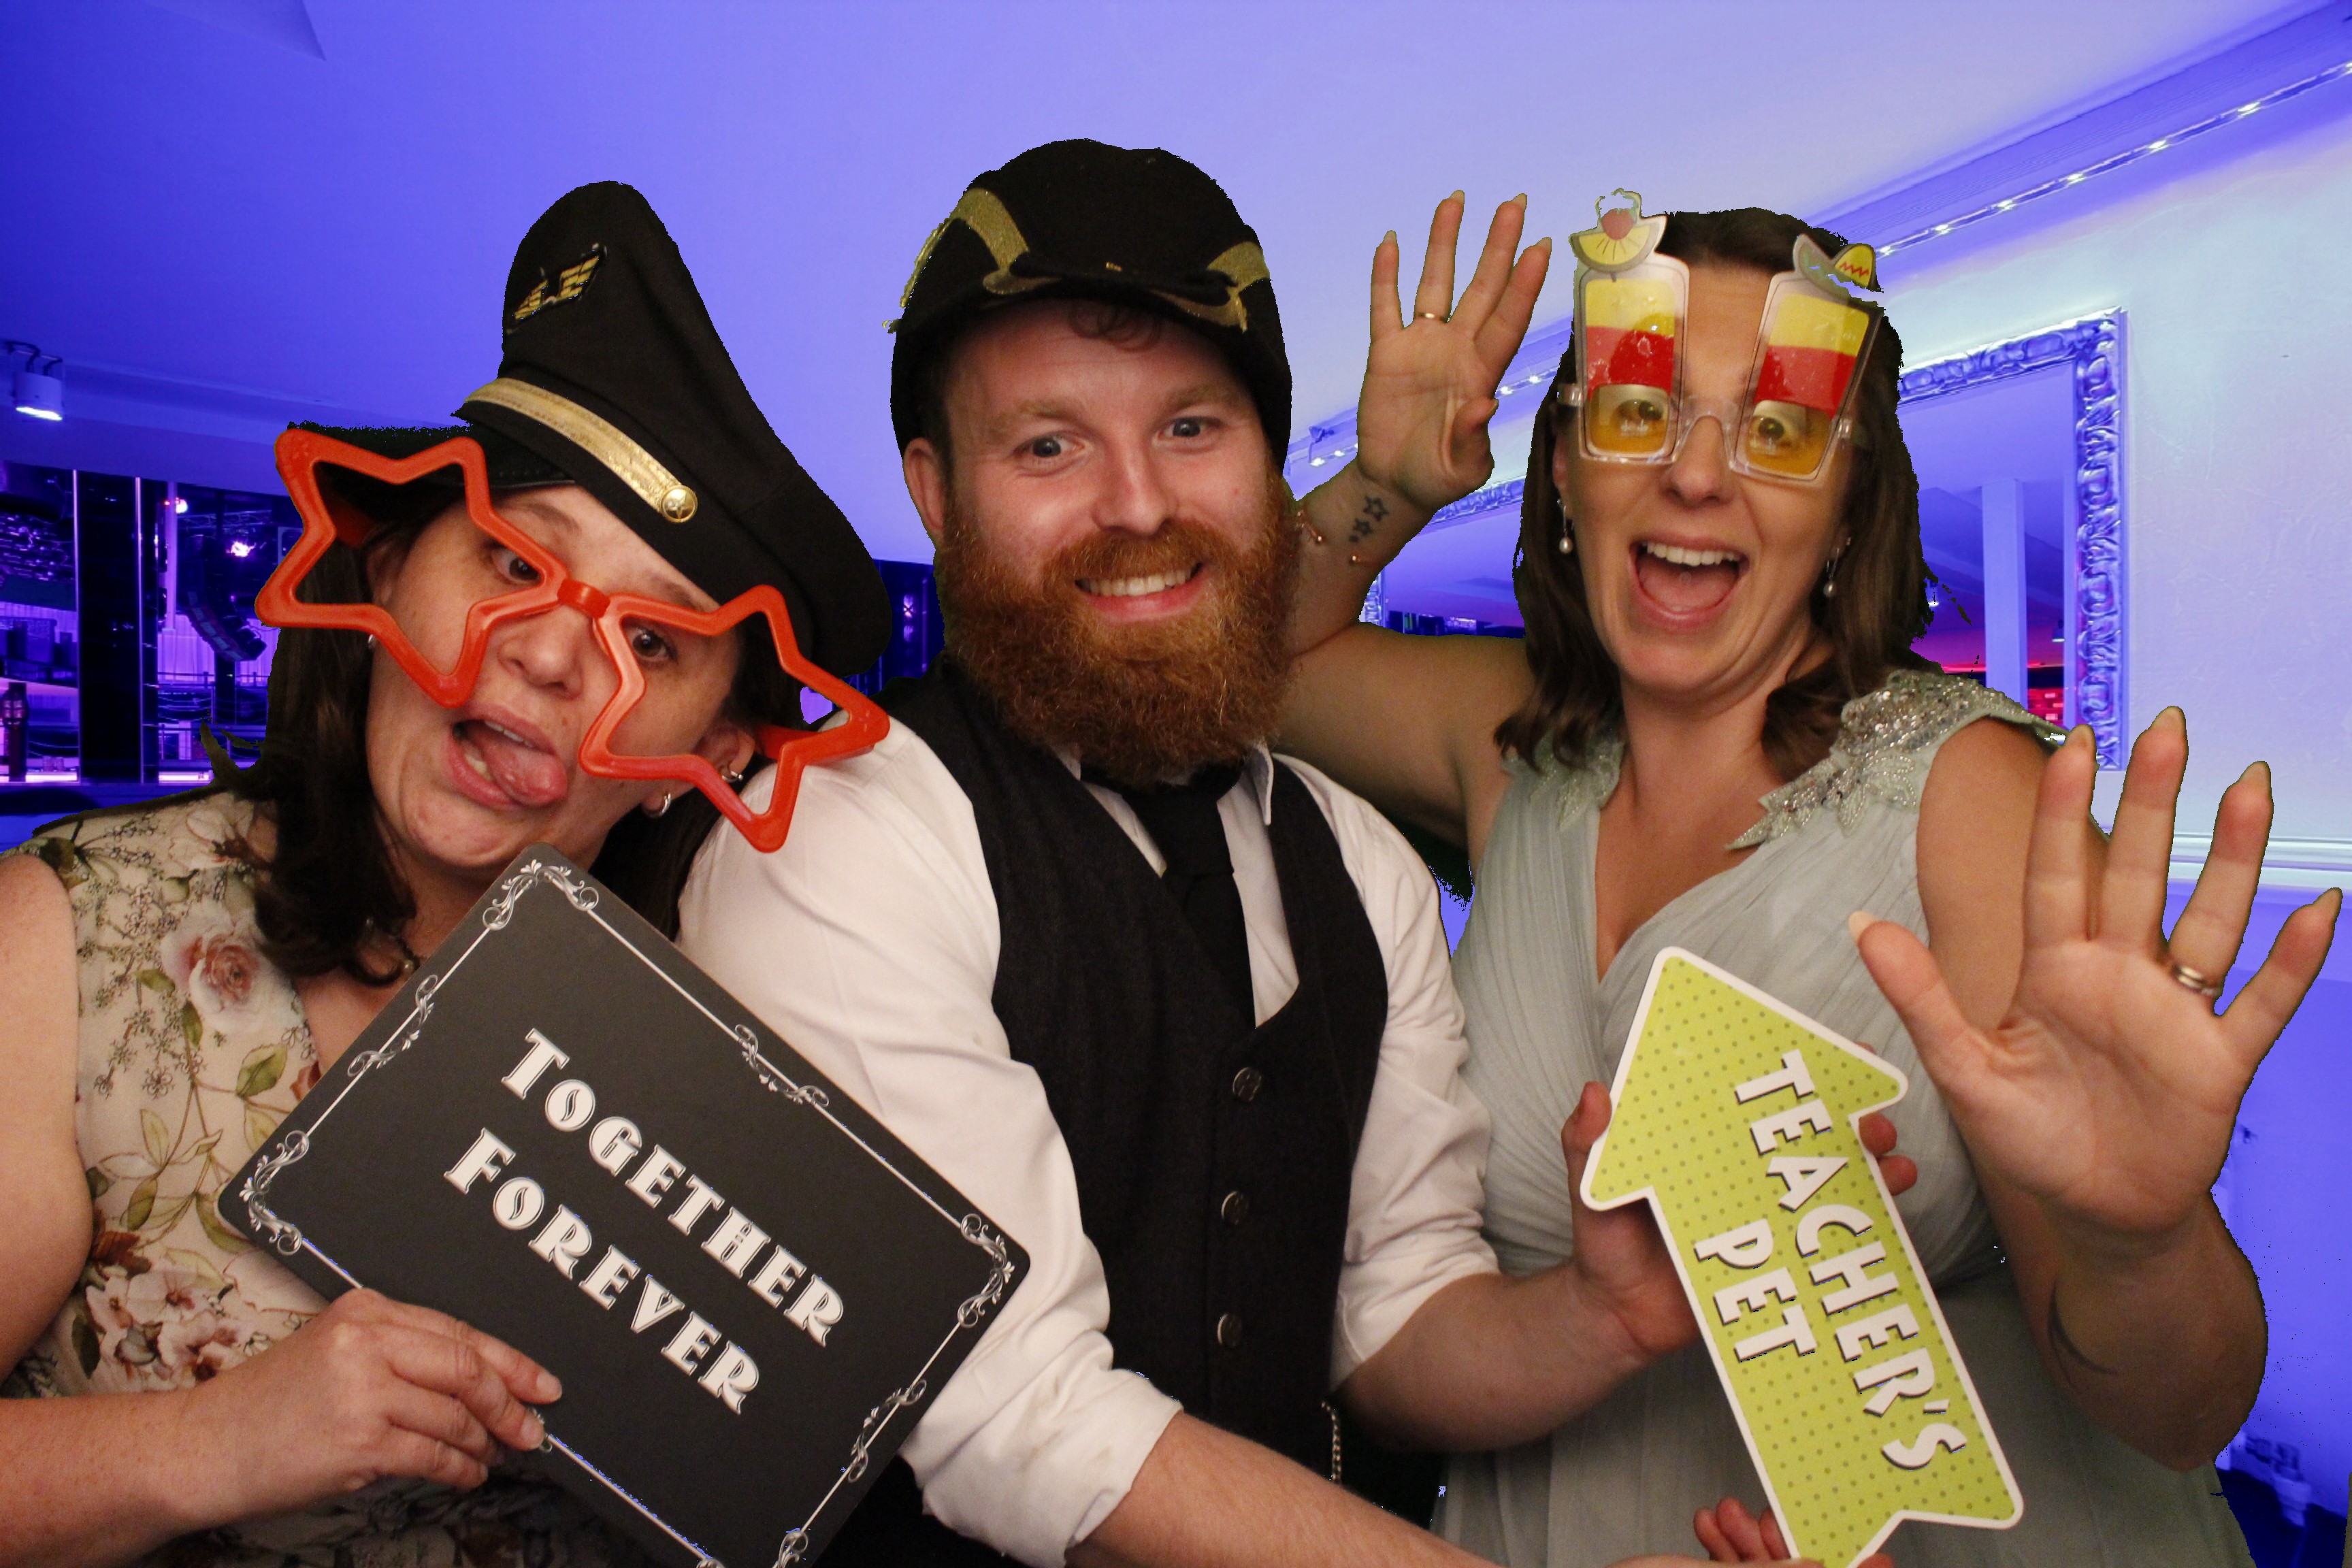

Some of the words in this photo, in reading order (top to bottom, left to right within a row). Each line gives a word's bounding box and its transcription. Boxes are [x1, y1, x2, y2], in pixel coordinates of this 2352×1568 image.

[443, 1127, 760, 1415] FOREVER
[501, 1028, 844, 1348] TOGETHER
[1694, 1218, 1818, 1362] PET
[1735, 1048, 1967, 1470] TEACHER'S
